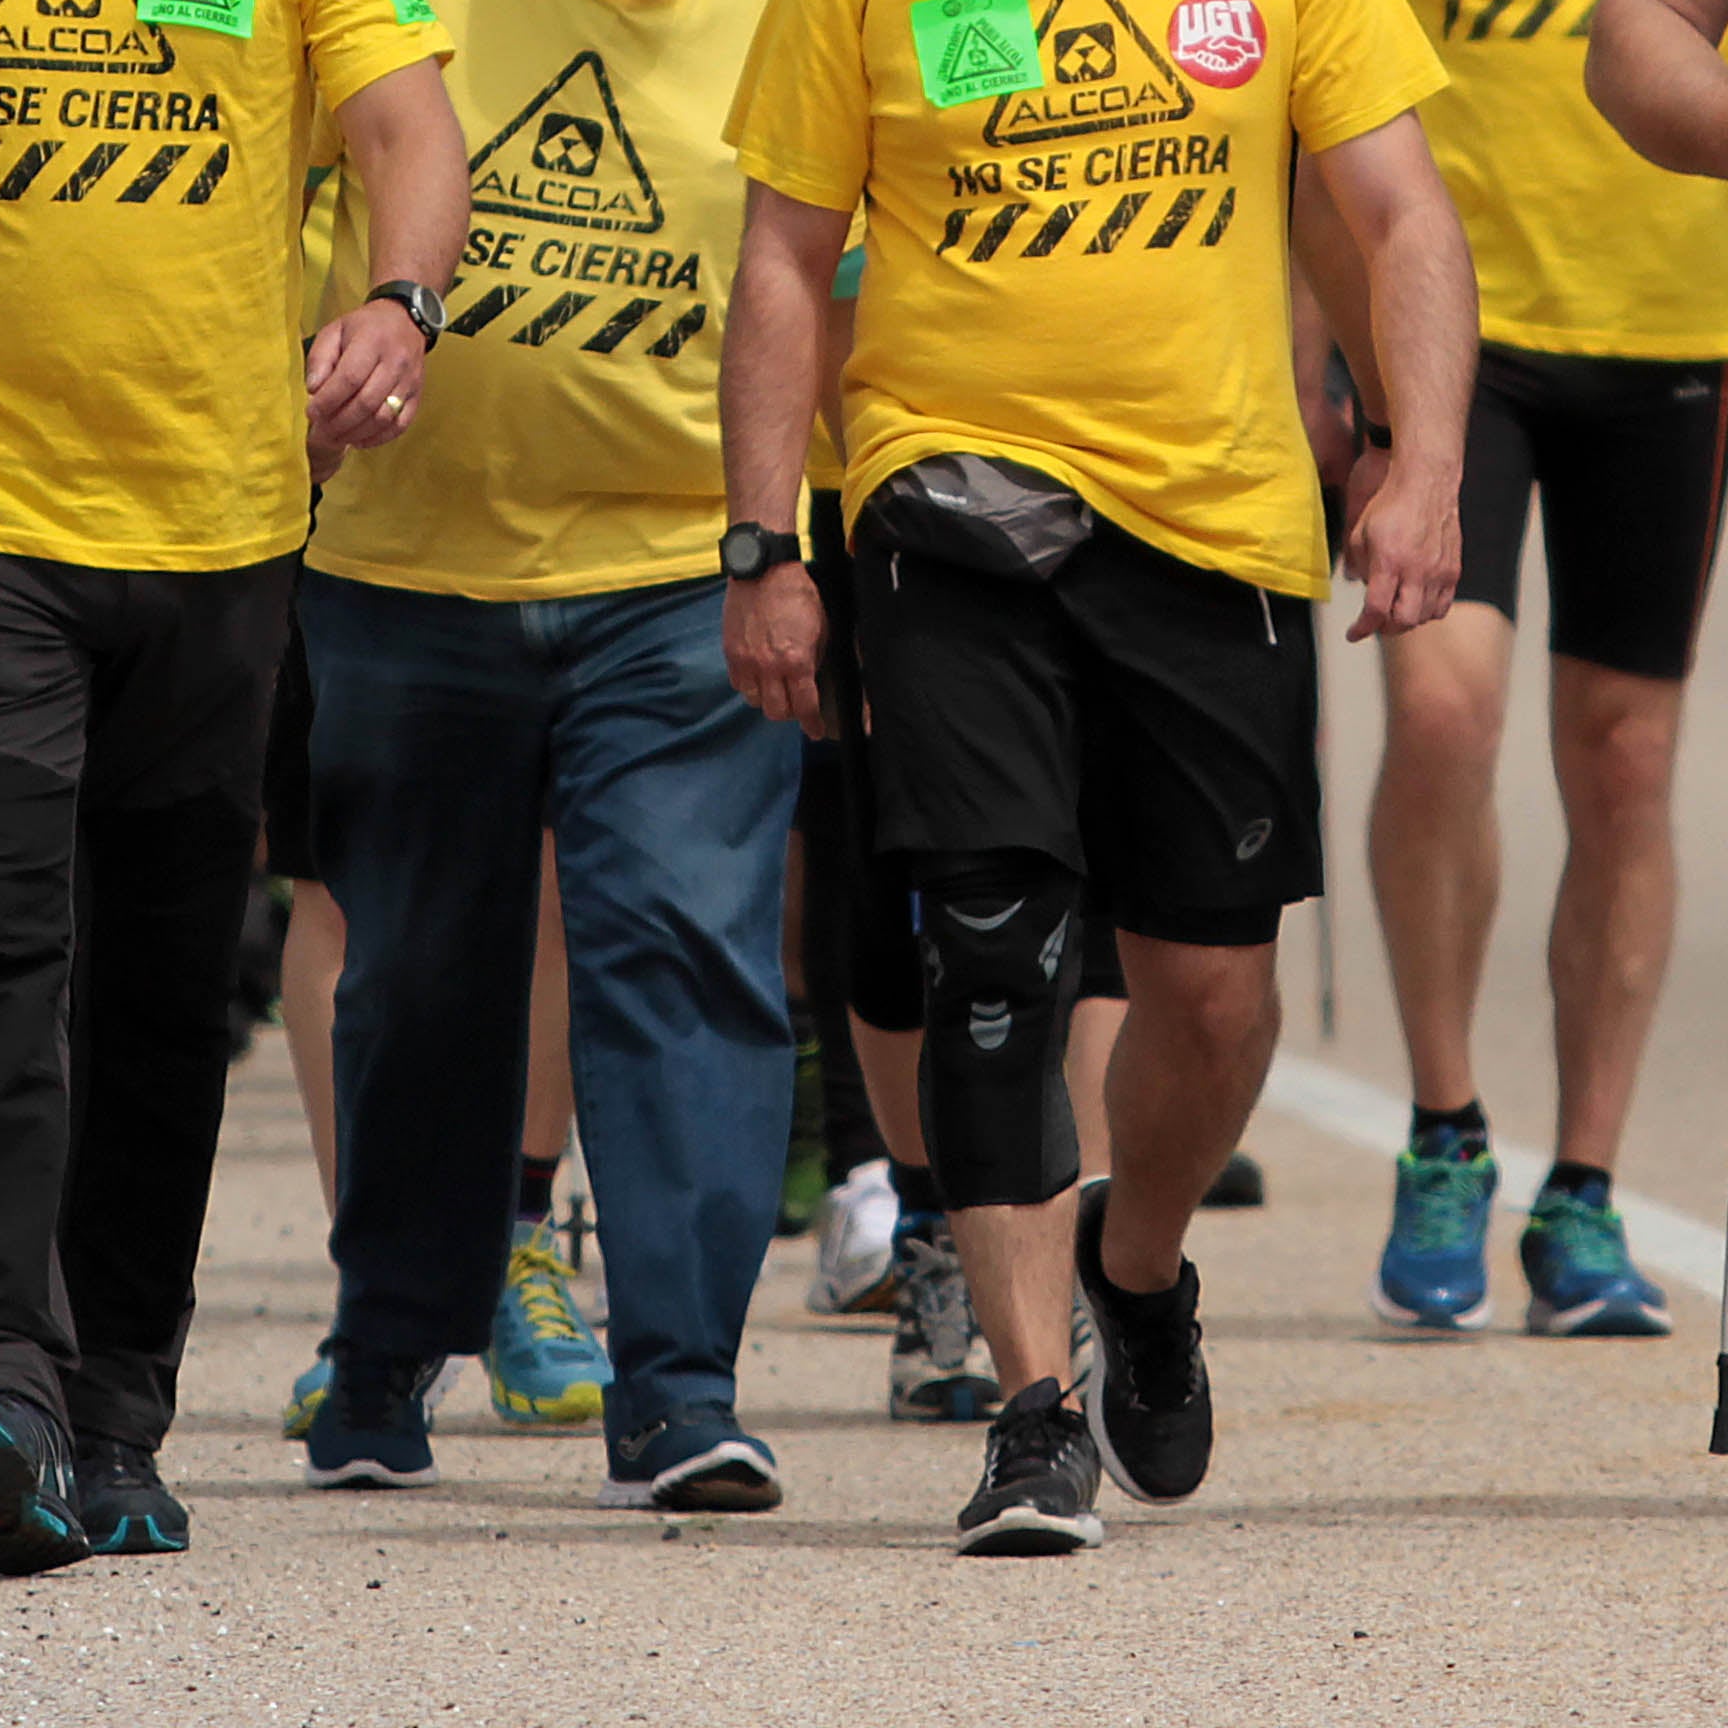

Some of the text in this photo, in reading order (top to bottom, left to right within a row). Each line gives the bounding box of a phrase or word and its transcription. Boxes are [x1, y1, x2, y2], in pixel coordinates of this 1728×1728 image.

[1178, 0, 1254, 45] UGT
[59, 86, 220, 132] CIERRA
[1009, 82, 1169, 128] ALCOA
[948, 135, 1232, 198] NO SE CIERRA
[473, 170, 639, 216] ALCOA
[462, 228, 701, 291] SE CIERRA
